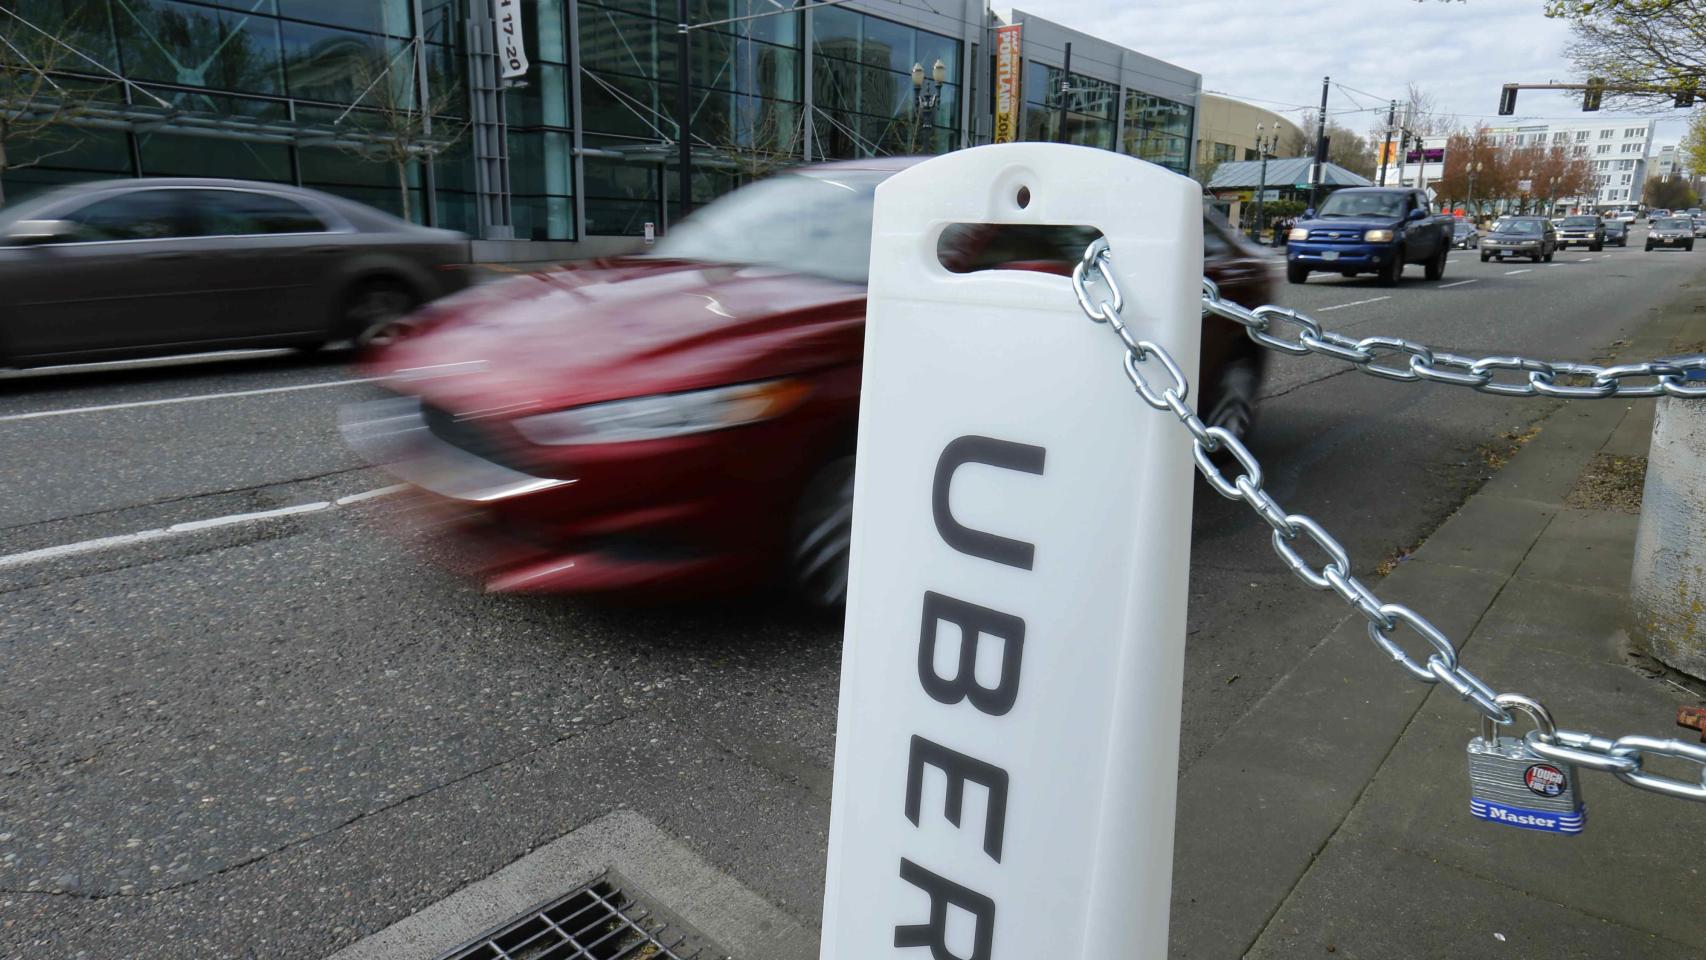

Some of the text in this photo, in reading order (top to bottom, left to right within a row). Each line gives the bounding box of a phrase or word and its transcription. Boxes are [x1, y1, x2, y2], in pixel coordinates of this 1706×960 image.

[502, 13, 521, 71] 17-20
[999, 31, 1012, 113] PORTLAND
[894, 434, 1047, 960] UBER
[1532, 767, 1563, 784] TOUGH
[1489, 807, 1556, 827] Master
